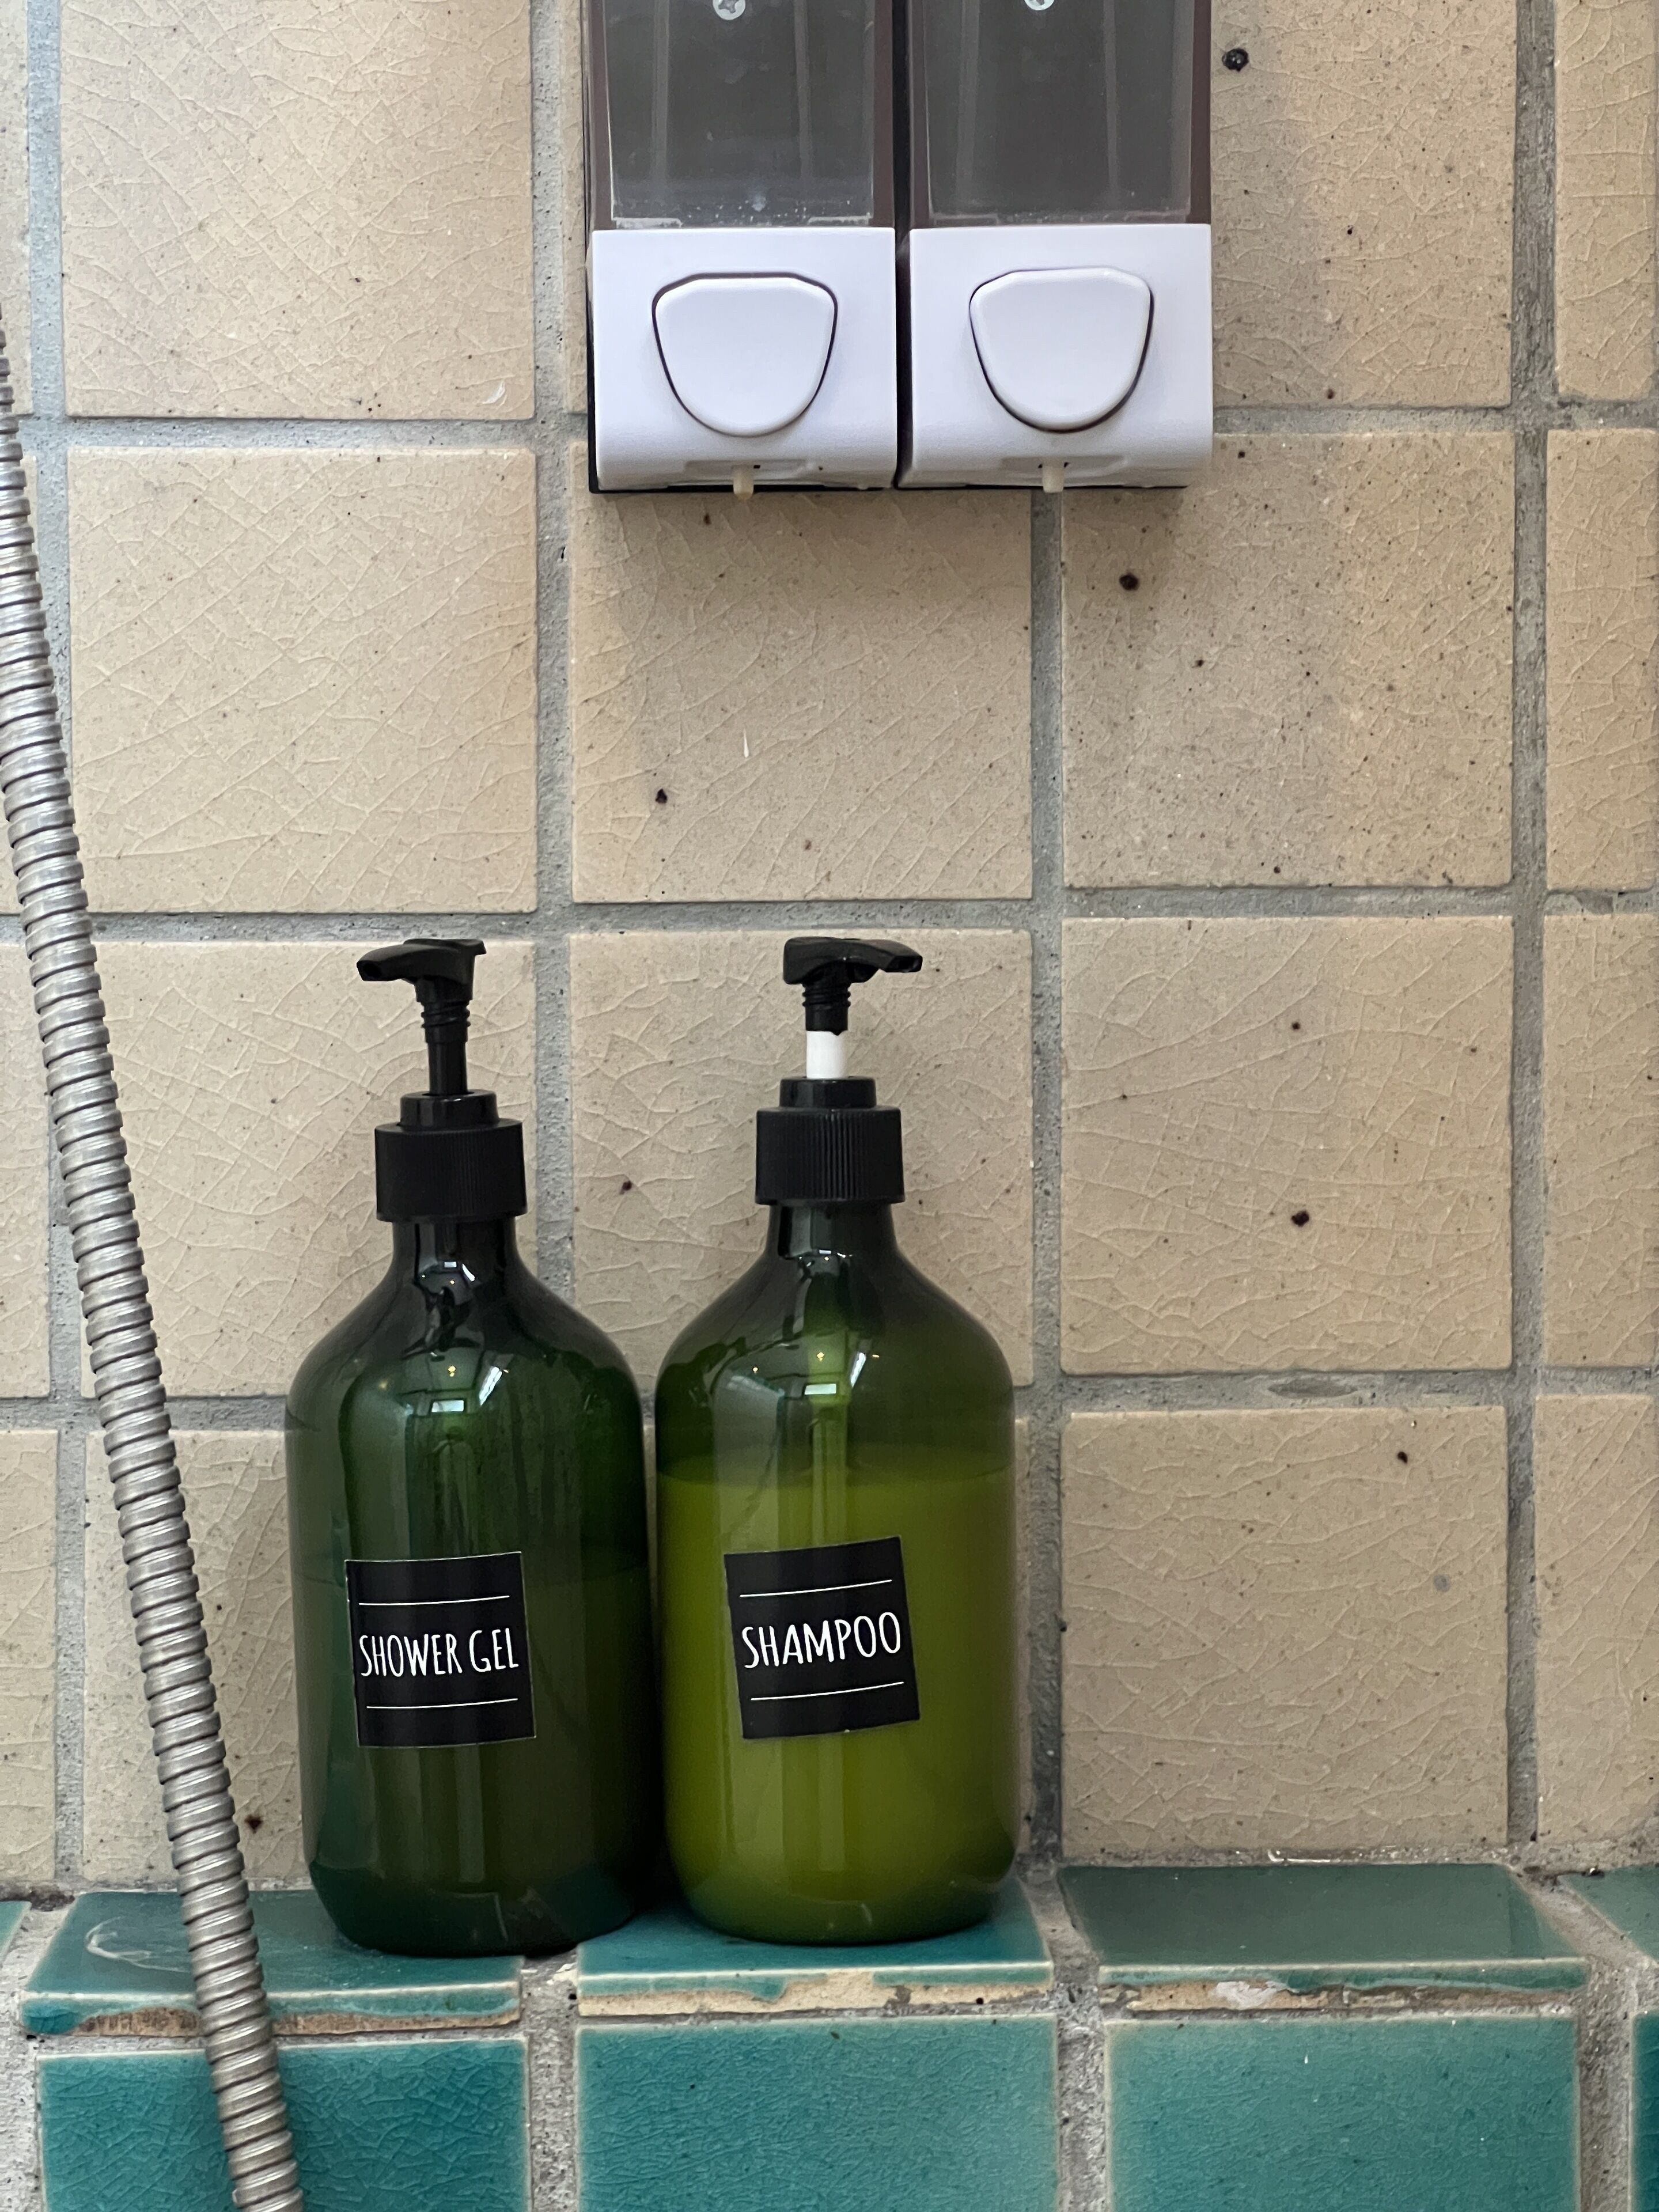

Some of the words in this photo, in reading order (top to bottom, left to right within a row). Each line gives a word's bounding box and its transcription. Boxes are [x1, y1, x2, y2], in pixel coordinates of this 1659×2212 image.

[359, 1633, 463, 1677] SHOWER
[469, 1627, 519, 1673] GEL
[741, 1612, 901, 1669] SHAMPOO
